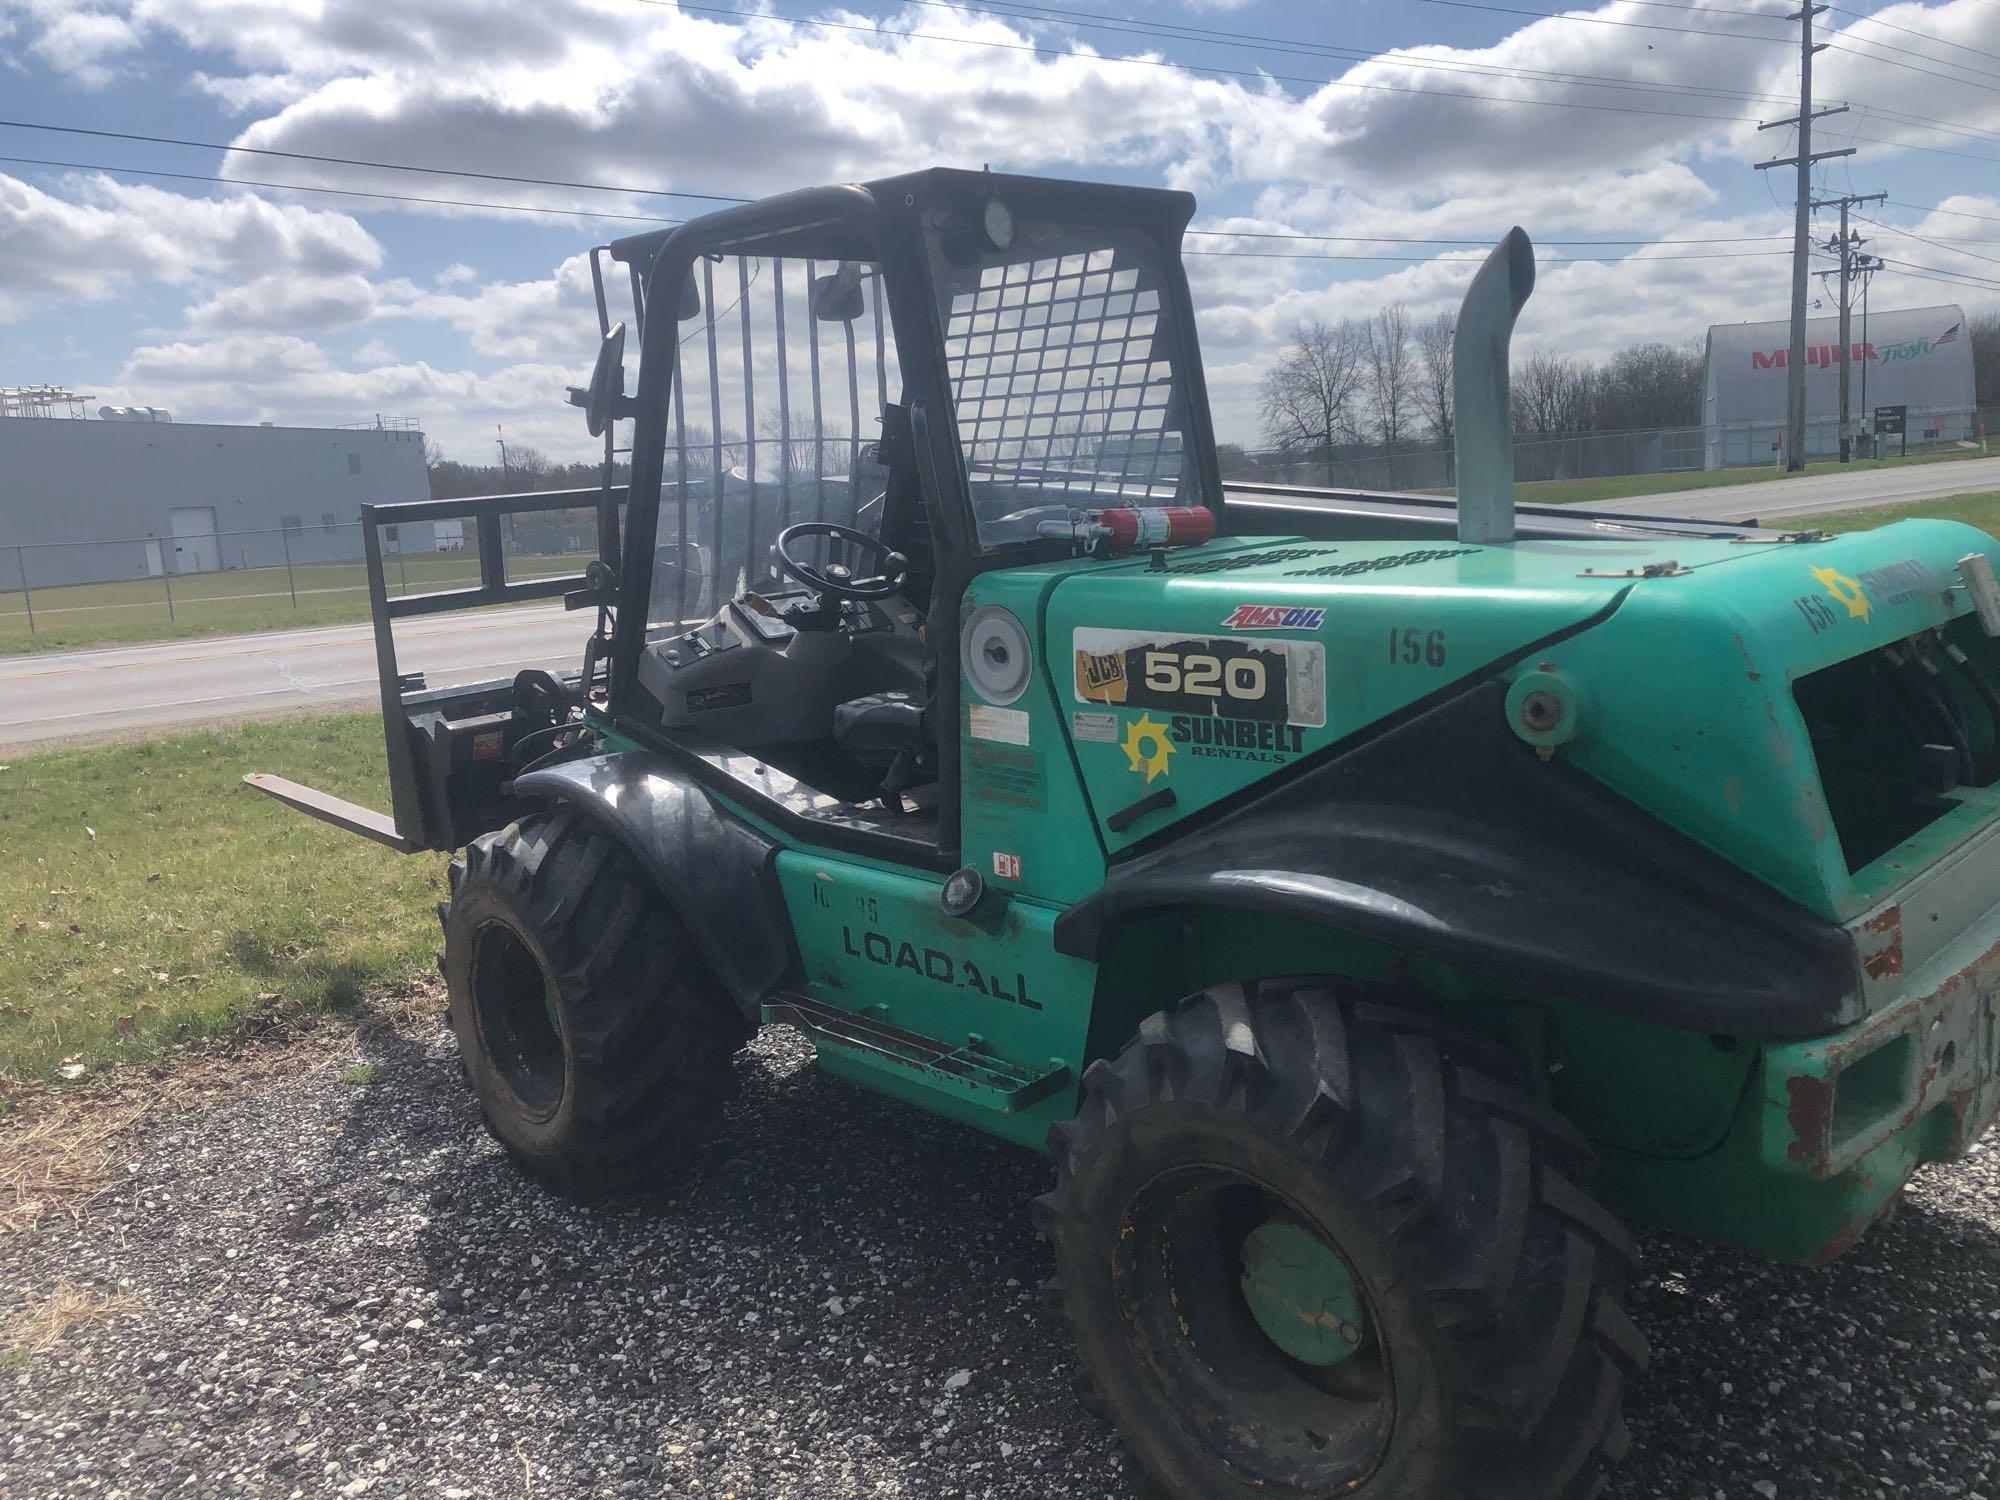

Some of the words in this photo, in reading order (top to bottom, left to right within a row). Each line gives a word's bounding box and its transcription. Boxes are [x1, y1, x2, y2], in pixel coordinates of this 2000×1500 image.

[1227, 605, 1323, 628] AMSOIL
[1389, 628, 1446, 667] 156
[1088, 654, 1120, 684] JCB
[1146, 651, 1266, 700] 520
[1171, 716, 1307, 753] SUNBELT
[1192, 747, 1285, 764] RENTALS
[842, 926, 1043, 1011] LOADALL
